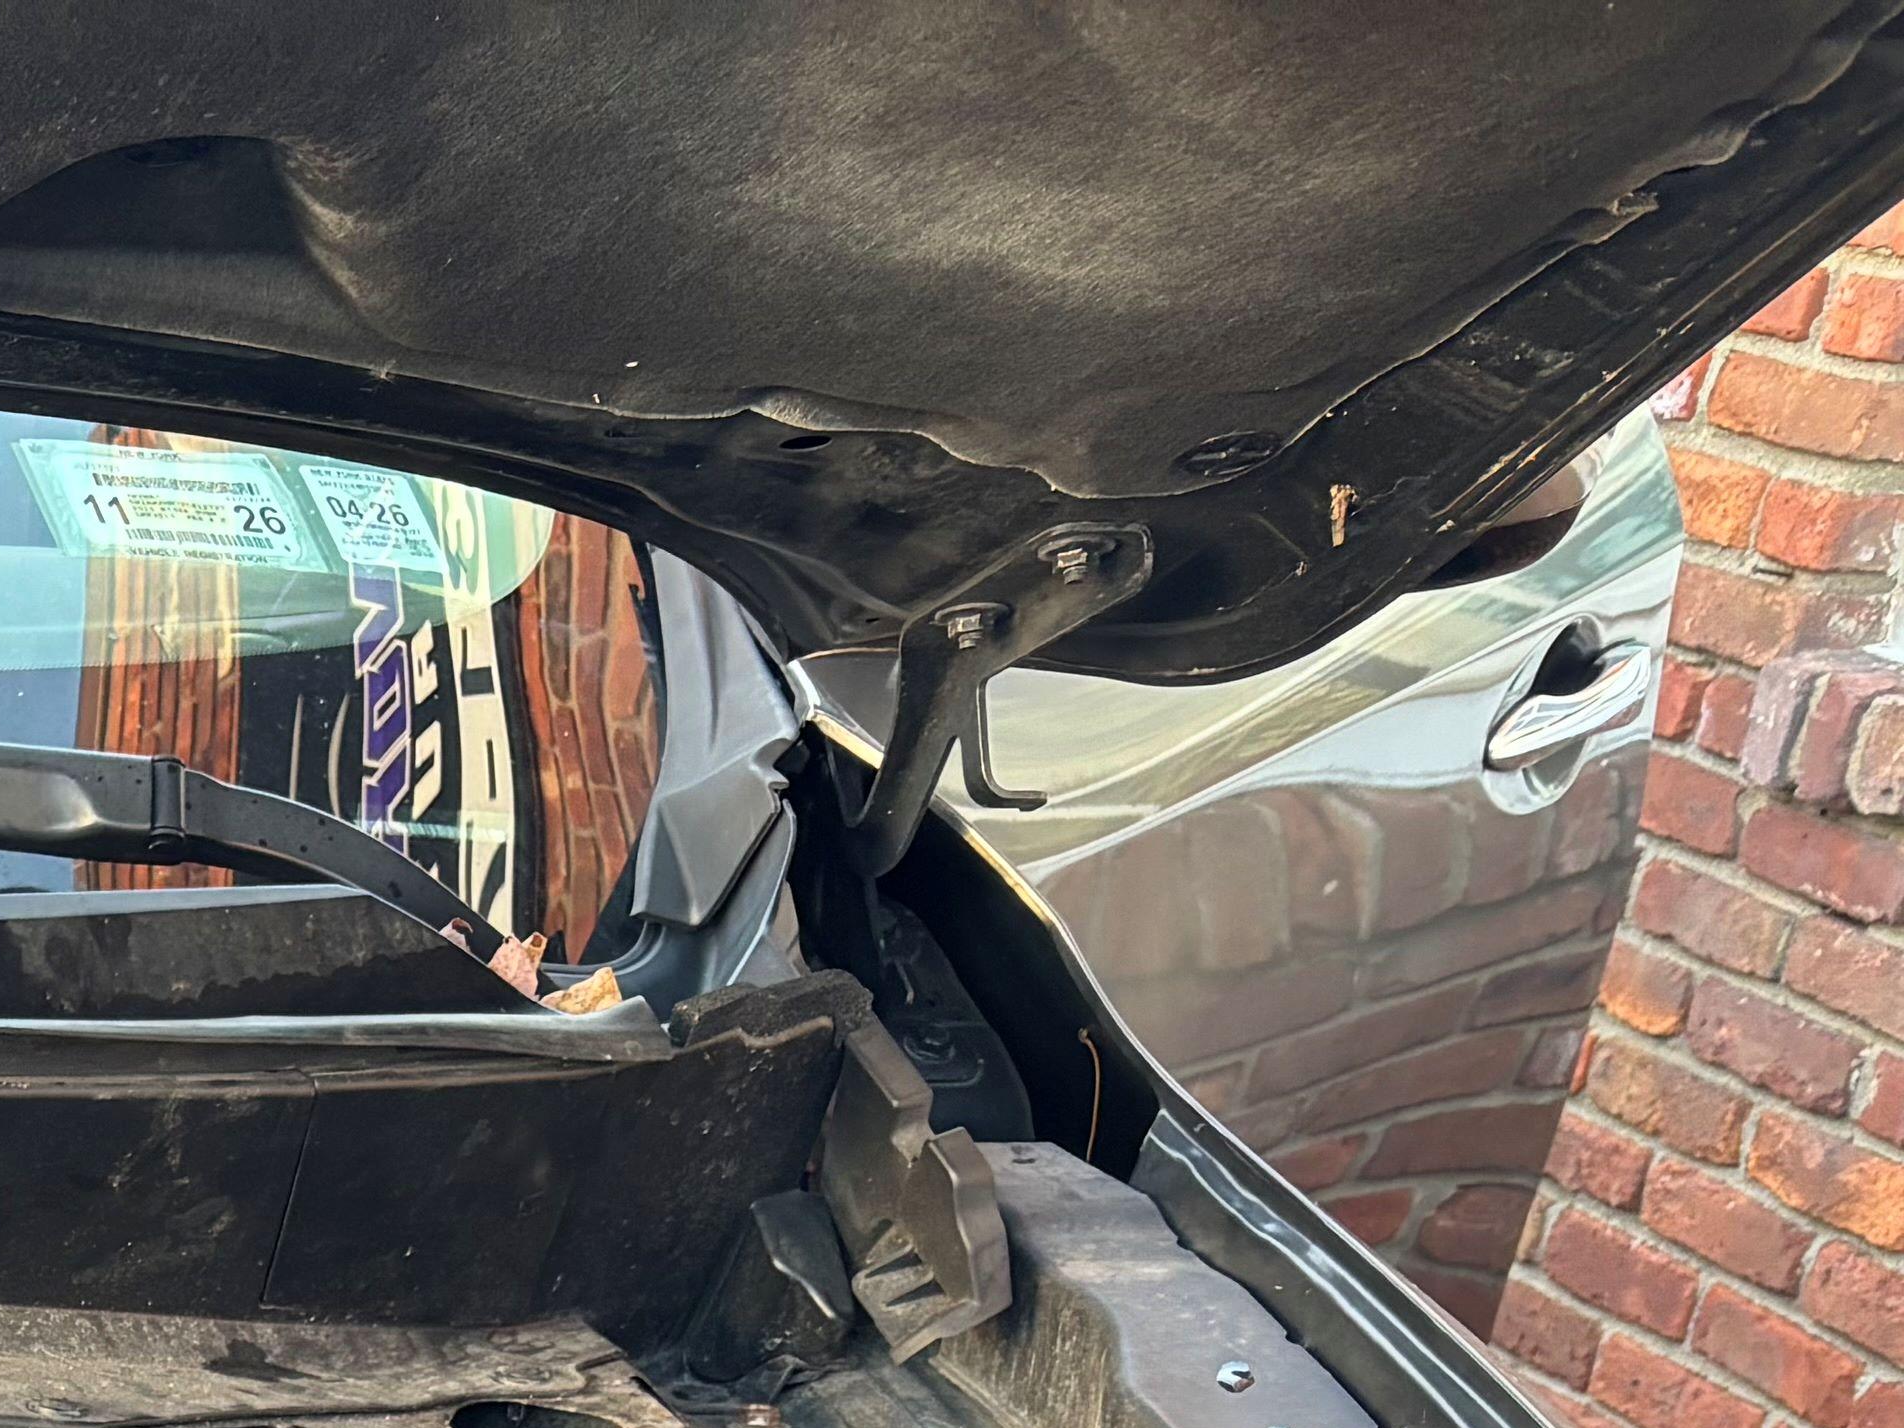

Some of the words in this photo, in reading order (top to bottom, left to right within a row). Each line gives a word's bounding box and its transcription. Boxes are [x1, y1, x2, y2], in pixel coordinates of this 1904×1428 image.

[83, 494, 130, 525] 11
[233, 505, 286, 535] 26
[325, 495, 364, 520] 04
[369, 501, 410, 526] 26
